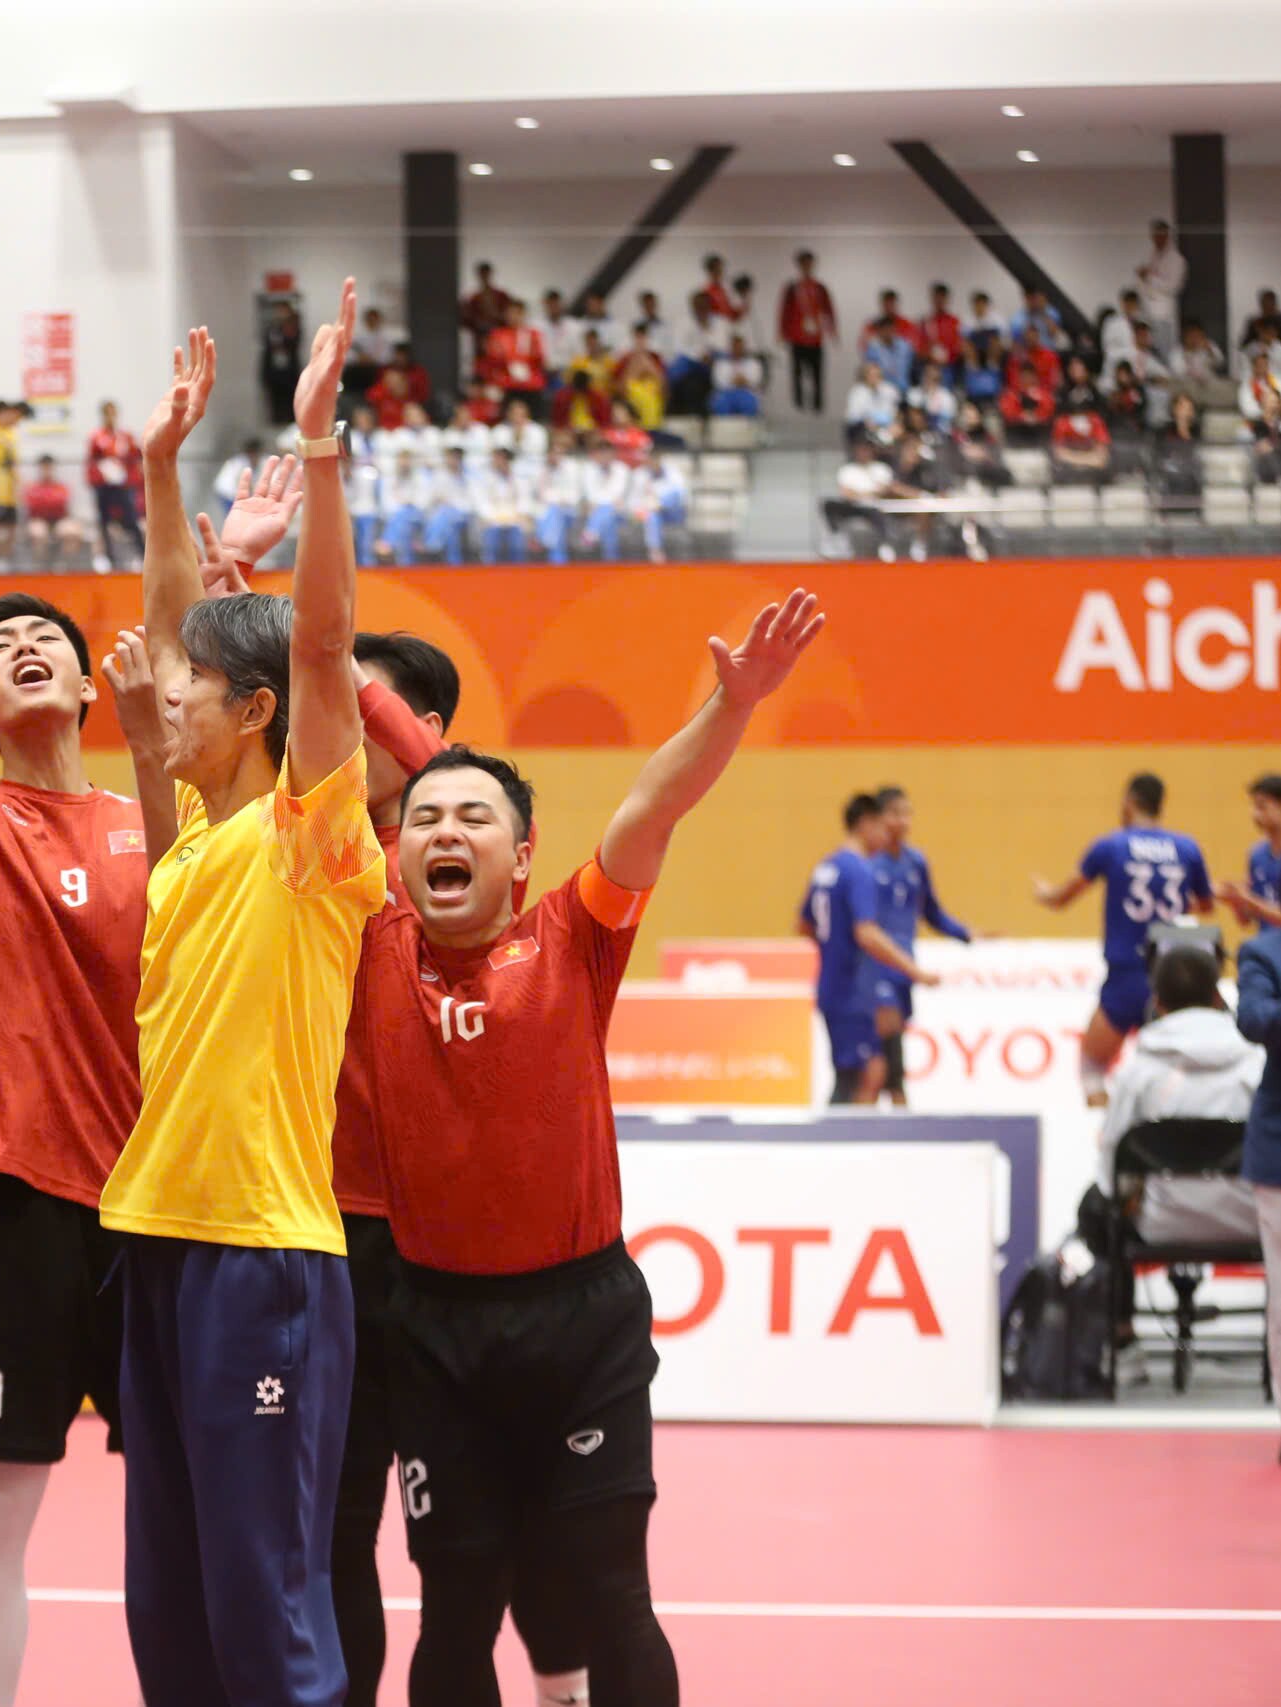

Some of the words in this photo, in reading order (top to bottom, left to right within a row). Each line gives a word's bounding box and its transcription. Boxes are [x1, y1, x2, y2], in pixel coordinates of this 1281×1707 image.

[60, 868, 88, 907] 9
[1123, 862, 1186, 924] 33
[625, 1223, 944, 1338] OTA
